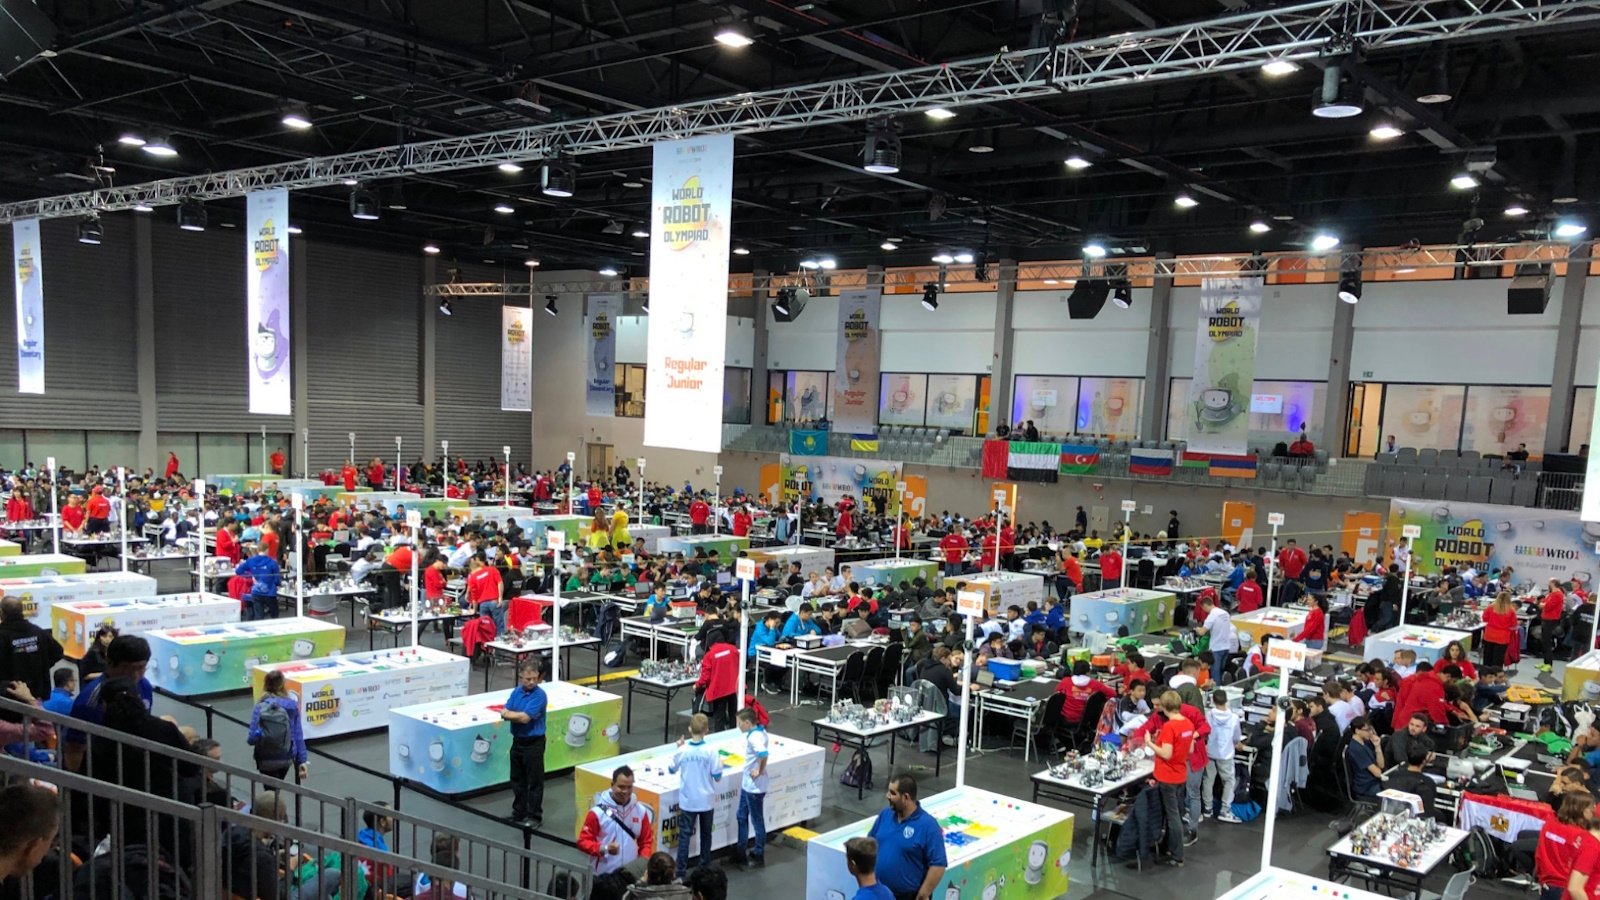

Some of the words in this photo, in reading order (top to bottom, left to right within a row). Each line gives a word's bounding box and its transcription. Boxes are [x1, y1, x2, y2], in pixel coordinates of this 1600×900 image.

[672, 187, 704, 200] WORLD
[663, 204, 711, 224] ROBOT
[259, 227, 275, 236] WORLD
[664, 229, 708, 243] OLYMPIAD
[255, 239, 279, 253] ROBOT
[1216, 307, 1240, 315] WORLD
[592, 322, 610, 330] ROBOT
[845, 321, 868, 330] ROBOT
[1209, 316, 1245, 327] ROBOT
[664, 356, 707, 374] Regular
[667, 375, 703, 390] Junior
[1447, 525, 1486, 538] WORLD
[1434, 538, 1495, 556] ROBOT
[312, 689, 335, 698] WORLD
[306, 697, 341, 712] ROBOT
[306, 711, 340, 722] OLYMPIAD
